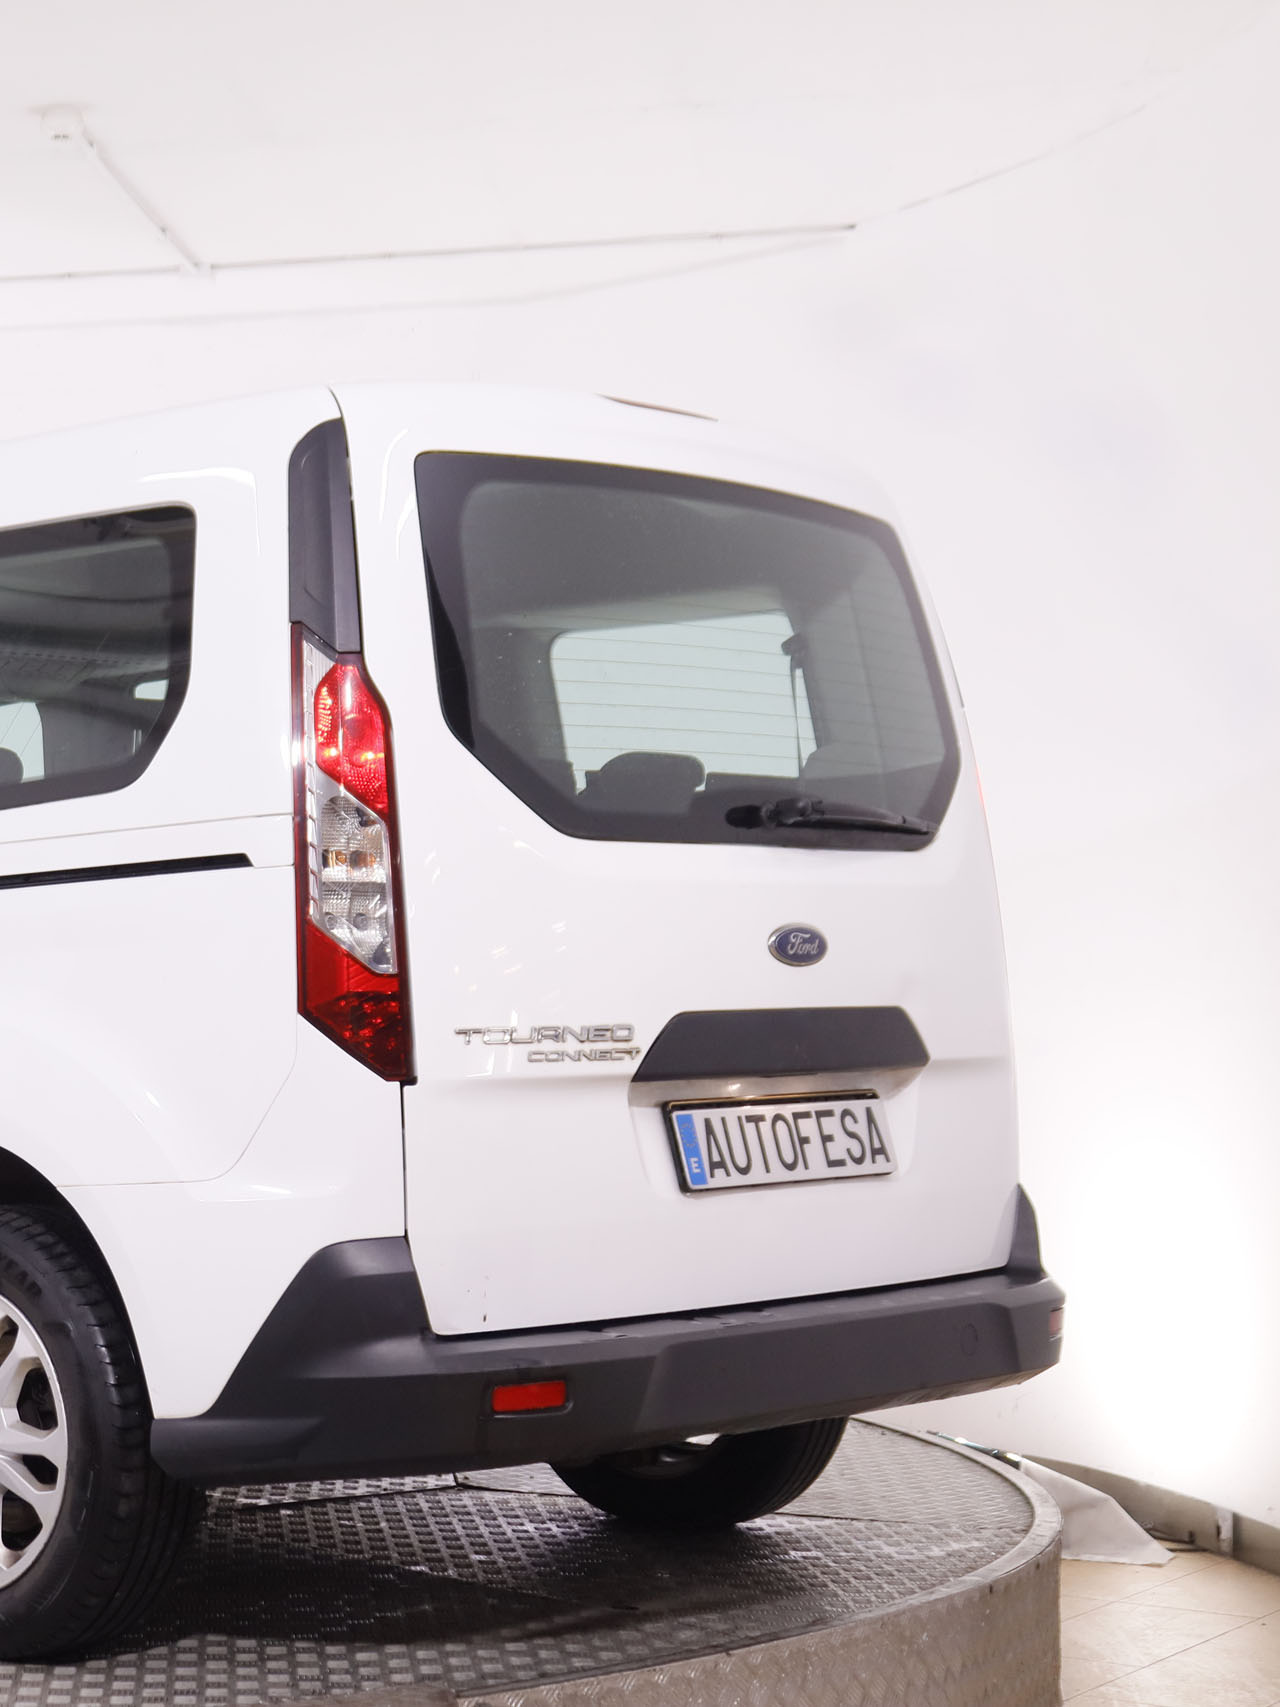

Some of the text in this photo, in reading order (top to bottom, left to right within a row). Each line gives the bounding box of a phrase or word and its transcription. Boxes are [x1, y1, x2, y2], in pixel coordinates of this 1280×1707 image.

[787, 931, 820, 955] Ford
[455, 1024, 635, 1046] TOURNEO
[527, 1047, 642, 1063] CONNECT
[703, 1106, 891, 1179] AUTOFESA
[689, 1157, 701, 1174] E
